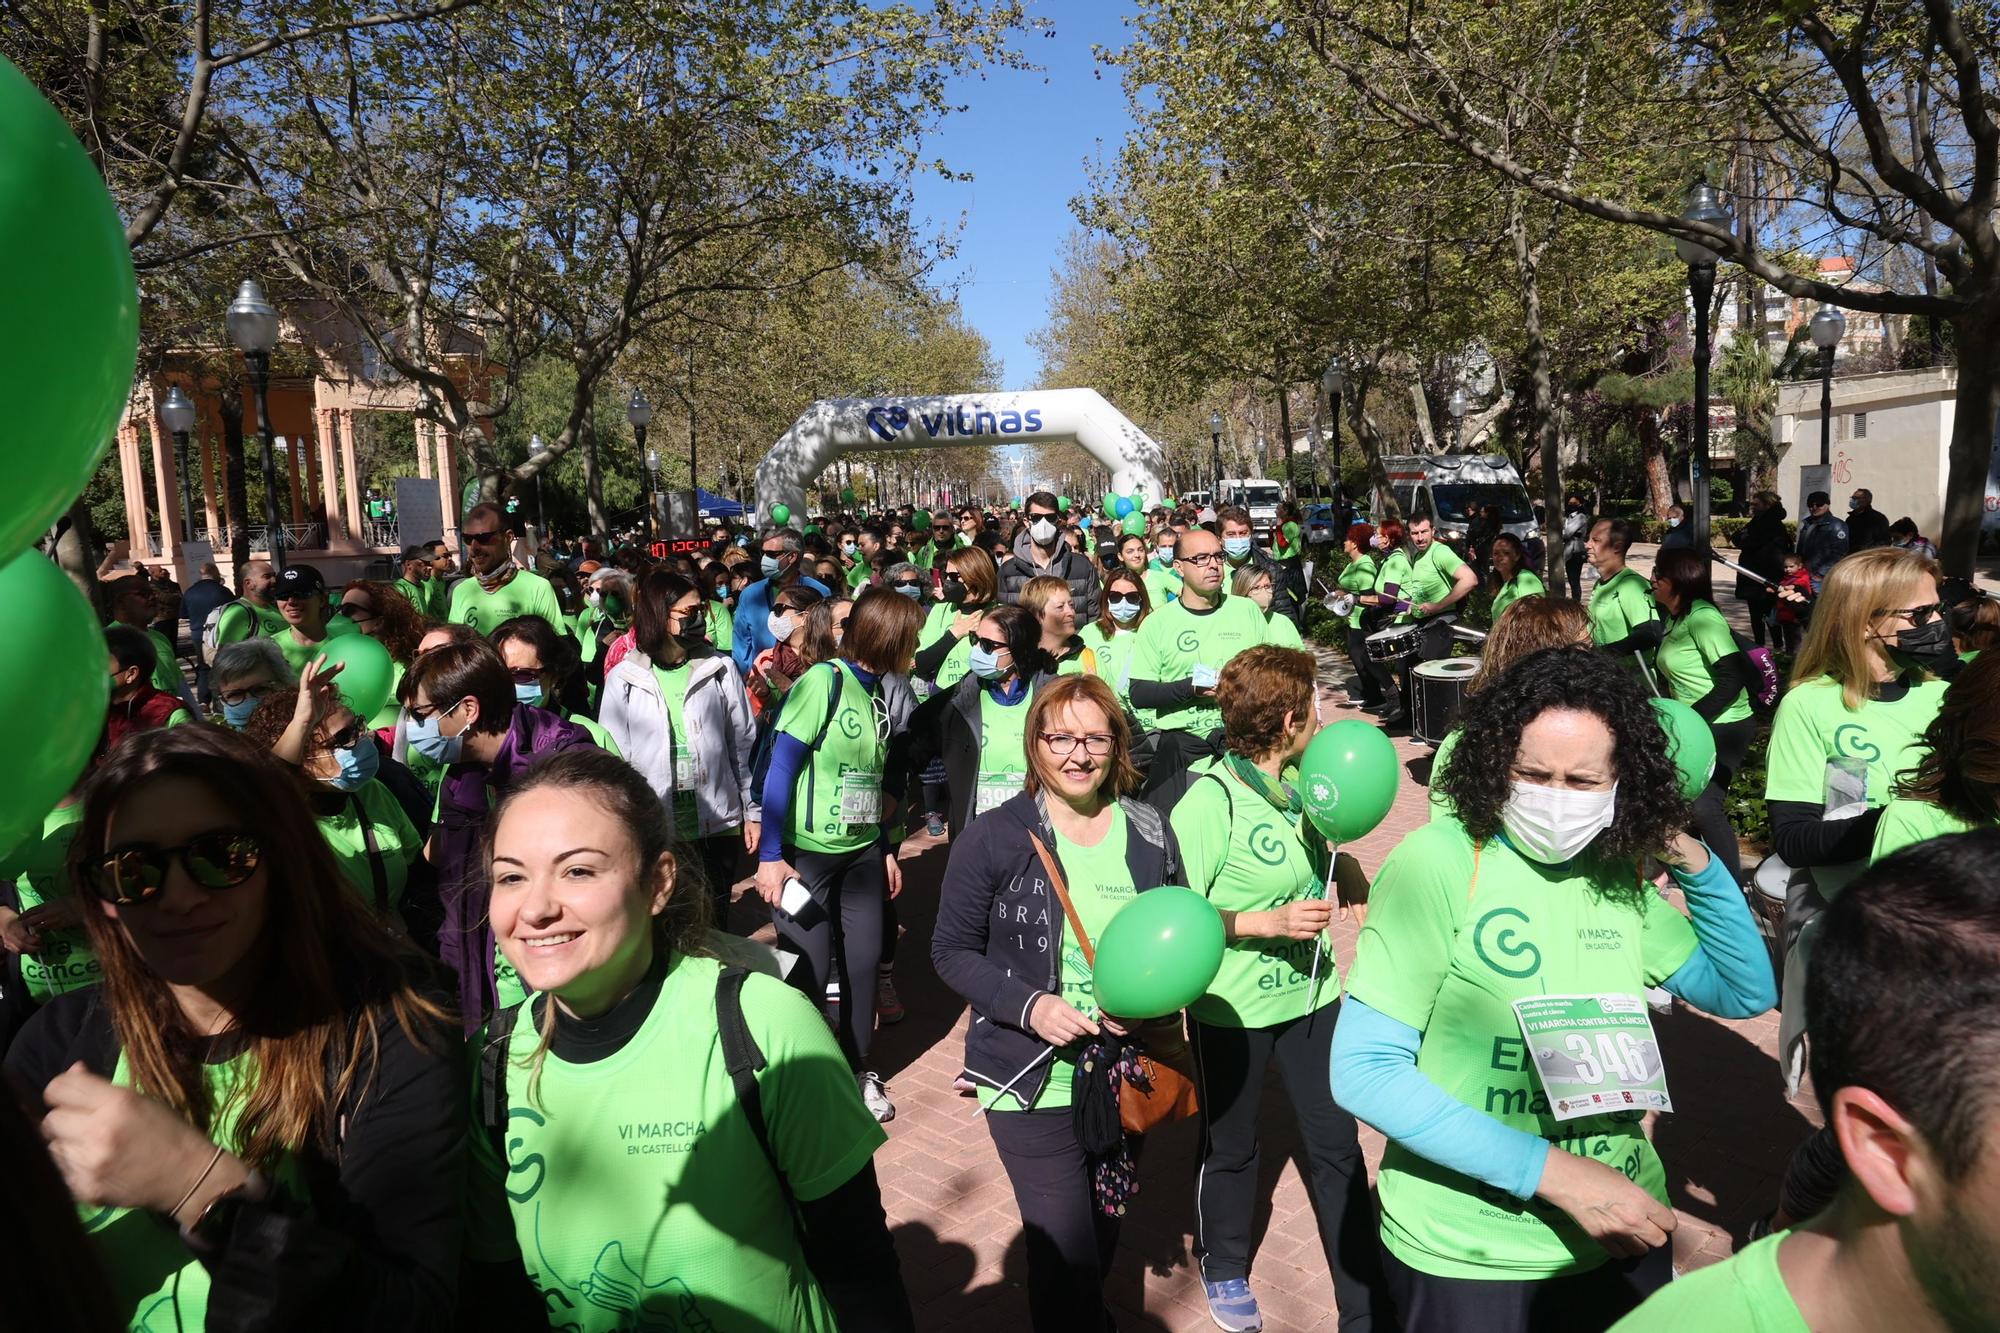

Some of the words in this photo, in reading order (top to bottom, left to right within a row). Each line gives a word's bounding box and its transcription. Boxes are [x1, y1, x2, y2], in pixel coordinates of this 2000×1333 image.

[1258, 967, 1283, 990] el
[1539, 1018, 1577, 1030] MARCHA
[1578, 1017, 1608, 1027] CONTRA
[1565, 1031, 1649, 1085] 346
[618, 1124, 633, 1140] VI
[638, 1120, 707, 1139] MARCHA
[627, 1145, 639, 1155] EN
